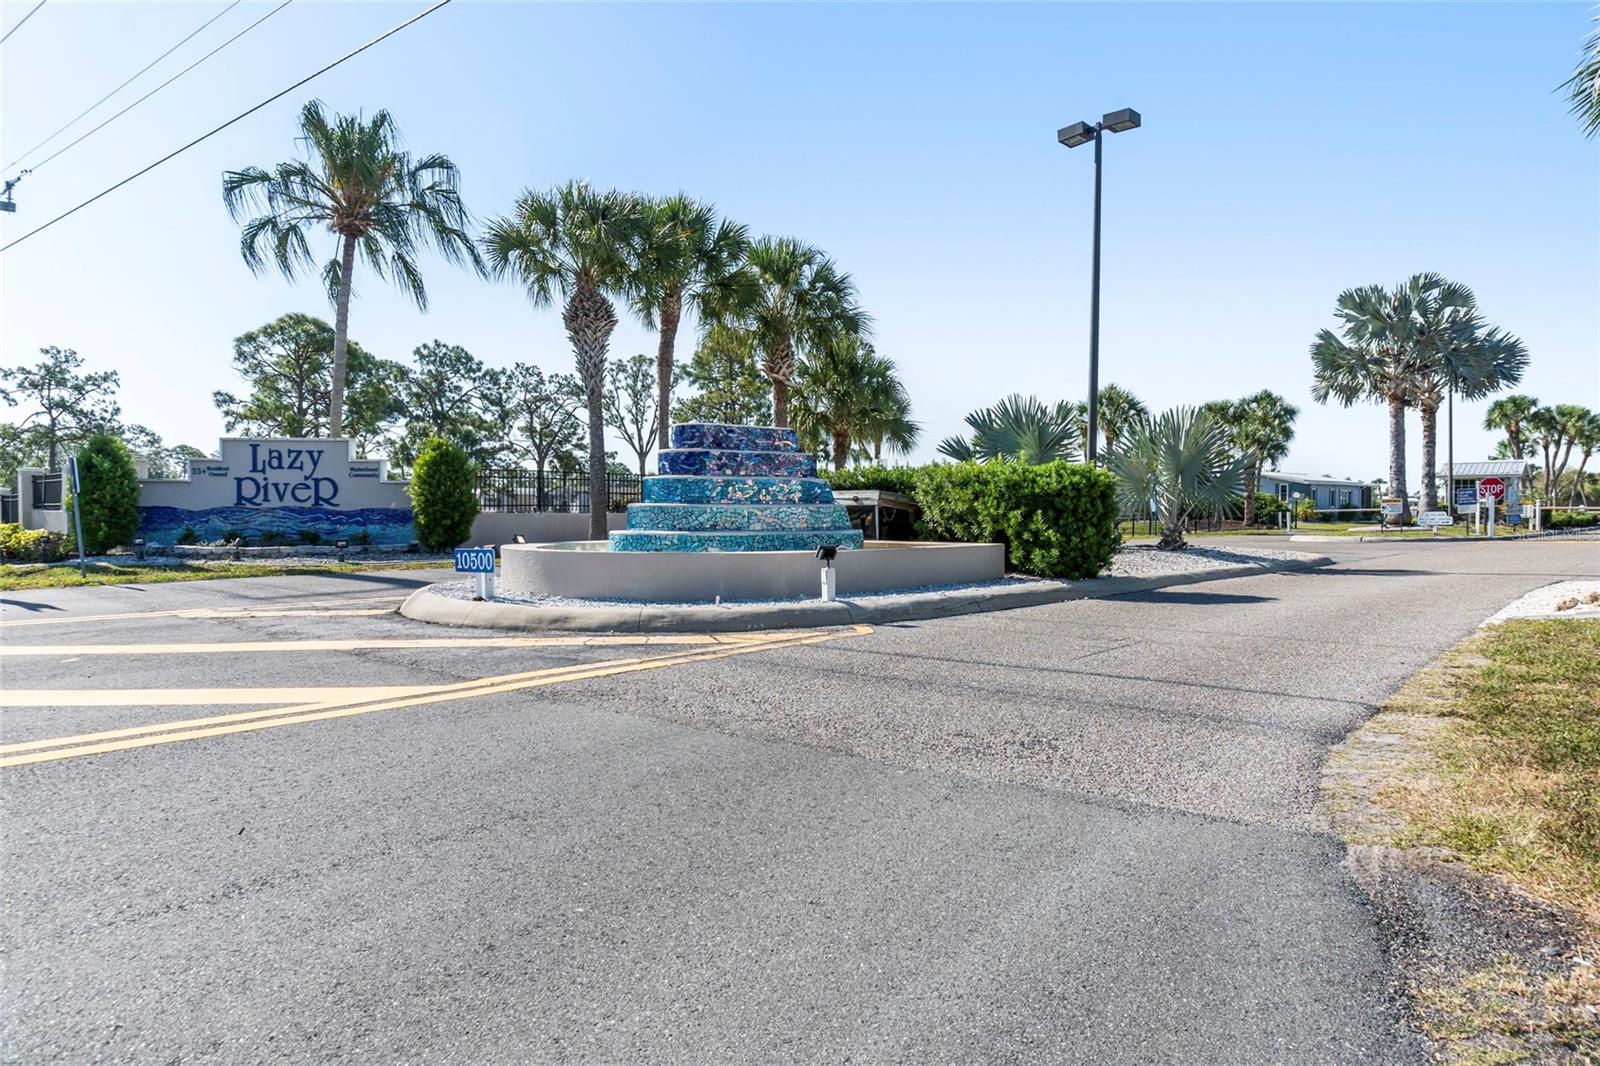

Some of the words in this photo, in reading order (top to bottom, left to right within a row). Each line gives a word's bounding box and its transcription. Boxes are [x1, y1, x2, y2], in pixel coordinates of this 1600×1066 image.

[249, 443, 324, 480] Lazy
[191, 467, 207, 475] 55+
[1480, 484, 1504, 495] STOP
[456, 551, 493, 570] 10500
